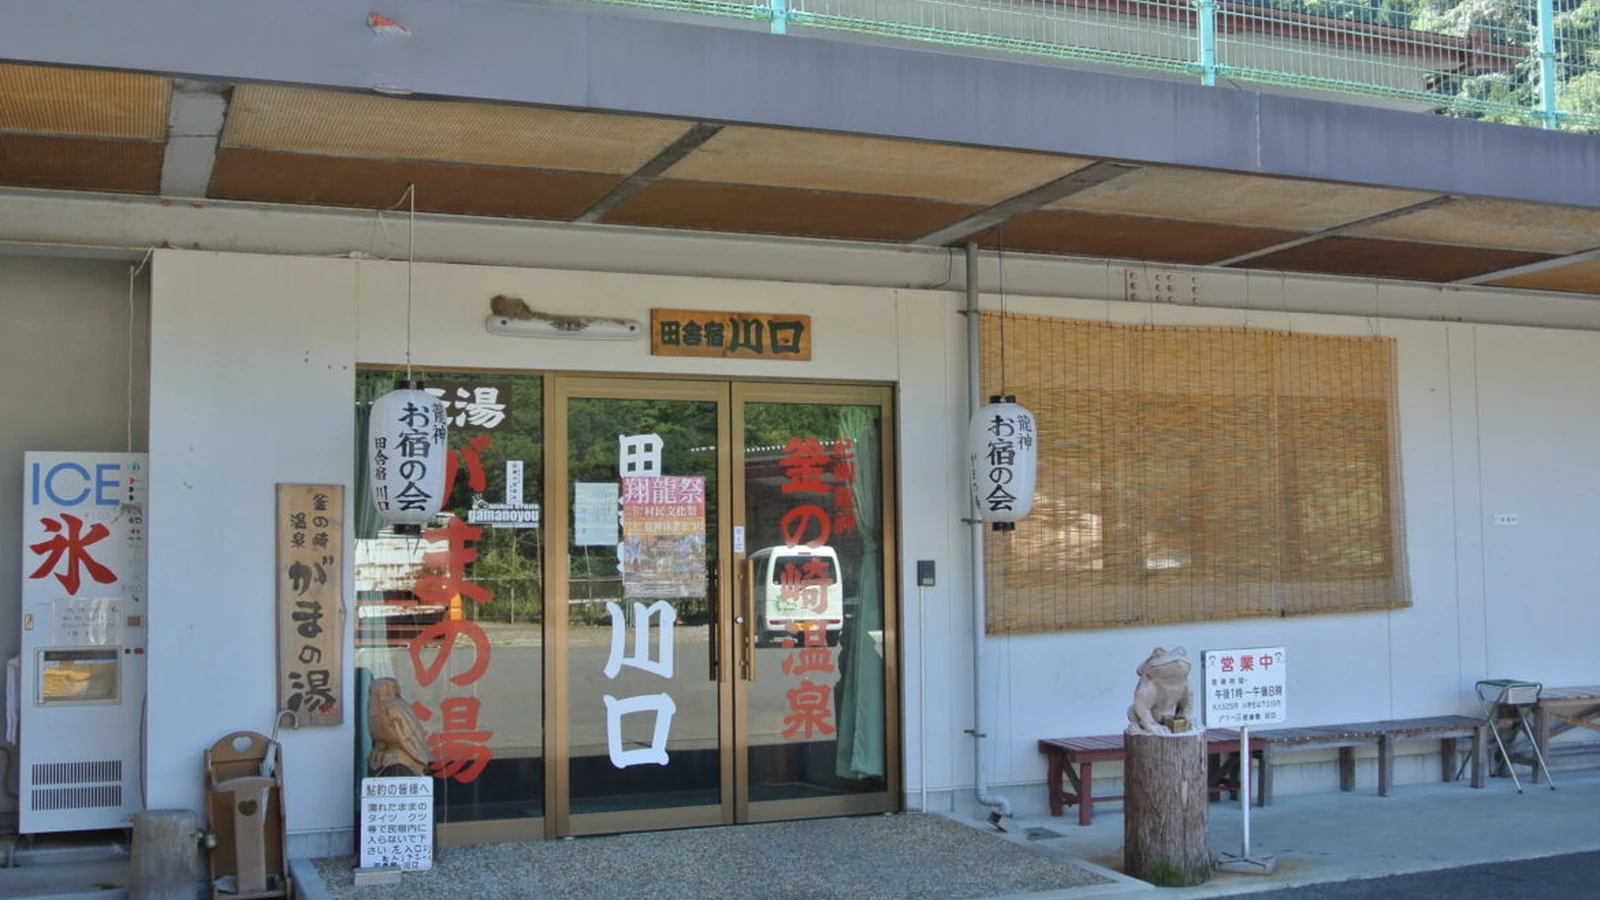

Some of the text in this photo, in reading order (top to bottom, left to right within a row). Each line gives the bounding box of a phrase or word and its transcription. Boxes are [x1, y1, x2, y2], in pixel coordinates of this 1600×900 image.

[1017, 414, 1033, 451] 龍神
[393, 401, 433, 512] お宿の会
[985, 414, 1017, 511] お宿の会
[32, 462, 121, 506] ICE
[624, 477, 703, 504] 翔龍祭
[290, 513, 307, 549] 温泉
[468, 510, 540, 524] gamanoyou
[28, 512, 118, 596] 氷
[287, 555, 336, 714] がまの湯
[1220, 653, 1274, 673] 営業中
[367, 834, 427, 845] 入らないで下
